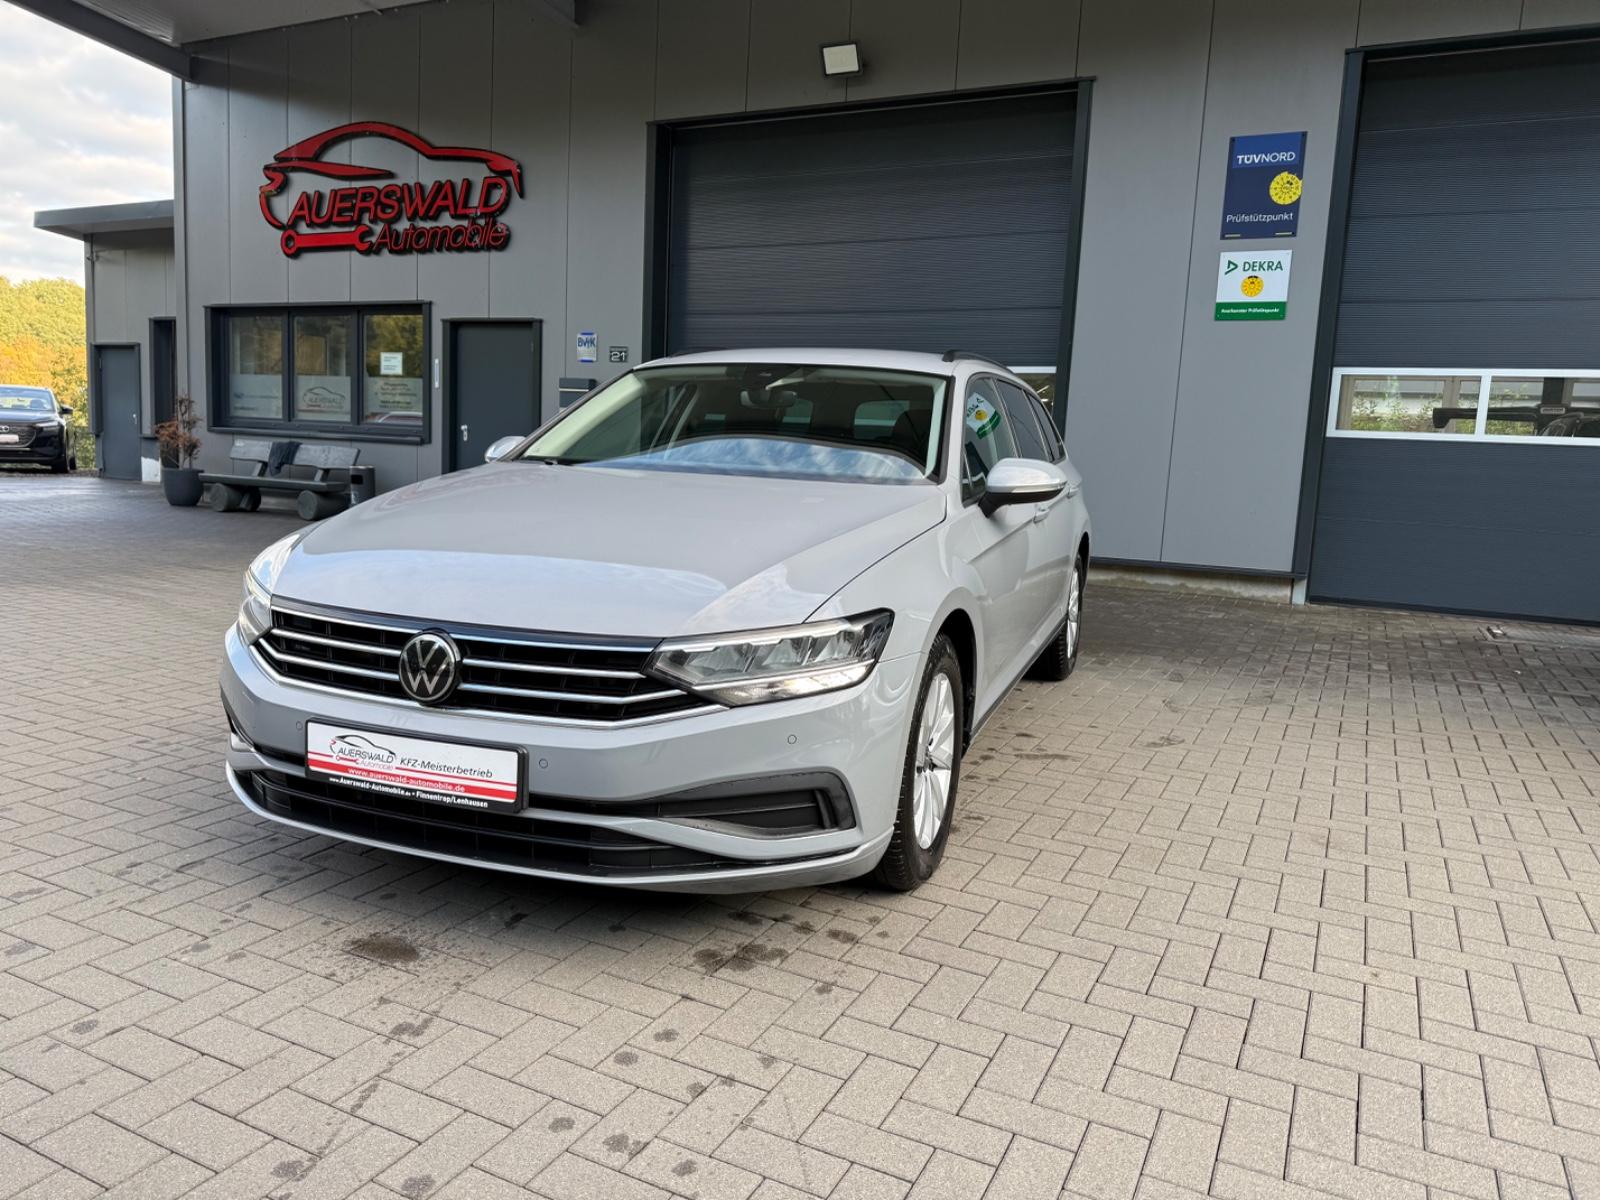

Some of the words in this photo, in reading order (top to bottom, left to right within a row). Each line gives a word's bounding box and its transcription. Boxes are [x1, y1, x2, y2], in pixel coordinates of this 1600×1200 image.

[287, 176, 511, 227] AUERSWALD
[1226, 212, 1294, 223] Prüfstützpunkt
[372, 218, 509, 252] Automobile
[1242, 260, 1284, 272] DEKRA
[611, 351, 626, 361] 21
[402, 640, 450, 695] VW
[338, 747, 394, 764] AUERSWALD
[400, 756, 493, 778] KFZ-Meisterbetrieb
[347, 768, 465, 793] www.auerswald-automobile.de
[416, 790, 489, 808] Finnentrop/Lenhausen
